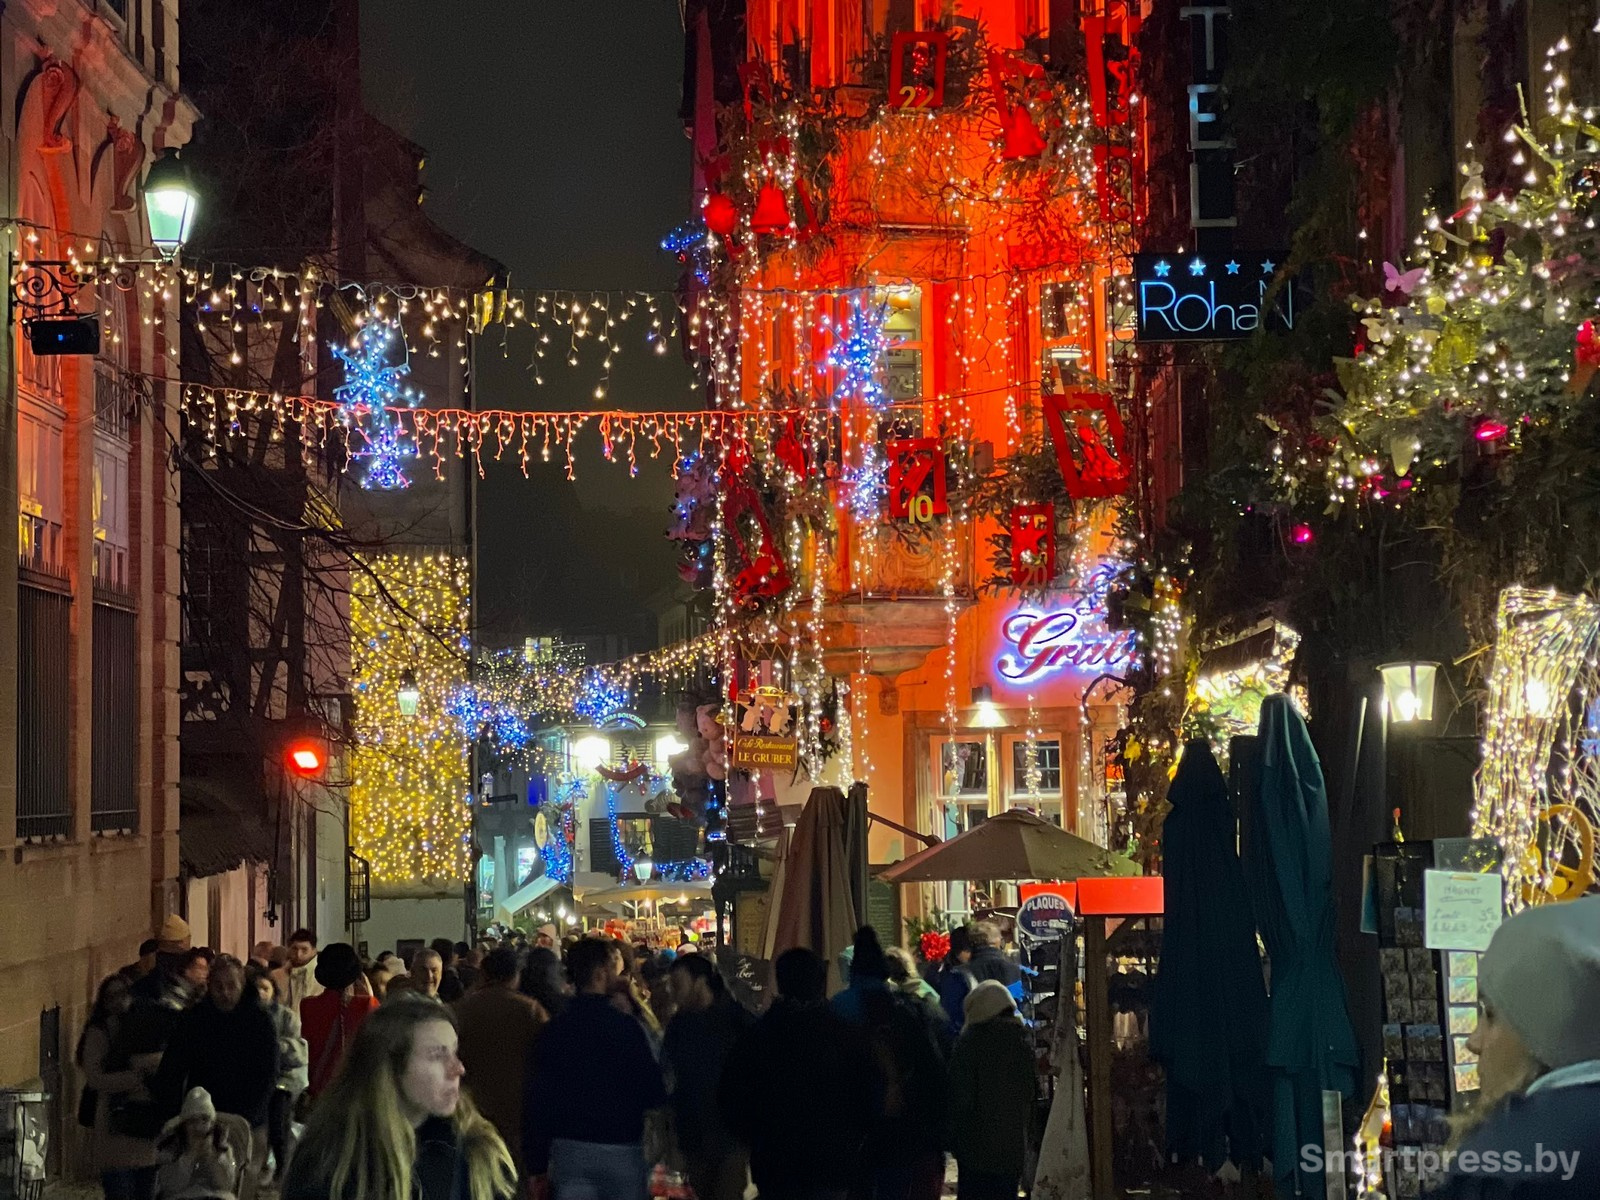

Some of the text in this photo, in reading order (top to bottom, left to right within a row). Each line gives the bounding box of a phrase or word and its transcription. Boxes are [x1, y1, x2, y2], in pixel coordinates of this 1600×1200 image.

[899, 85, 935, 112] 22
[908, 494, 934, 524] 10
[738, 751, 793, 764] LE GRUBER
[1027, 896, 1065, 911] PLAQUES
